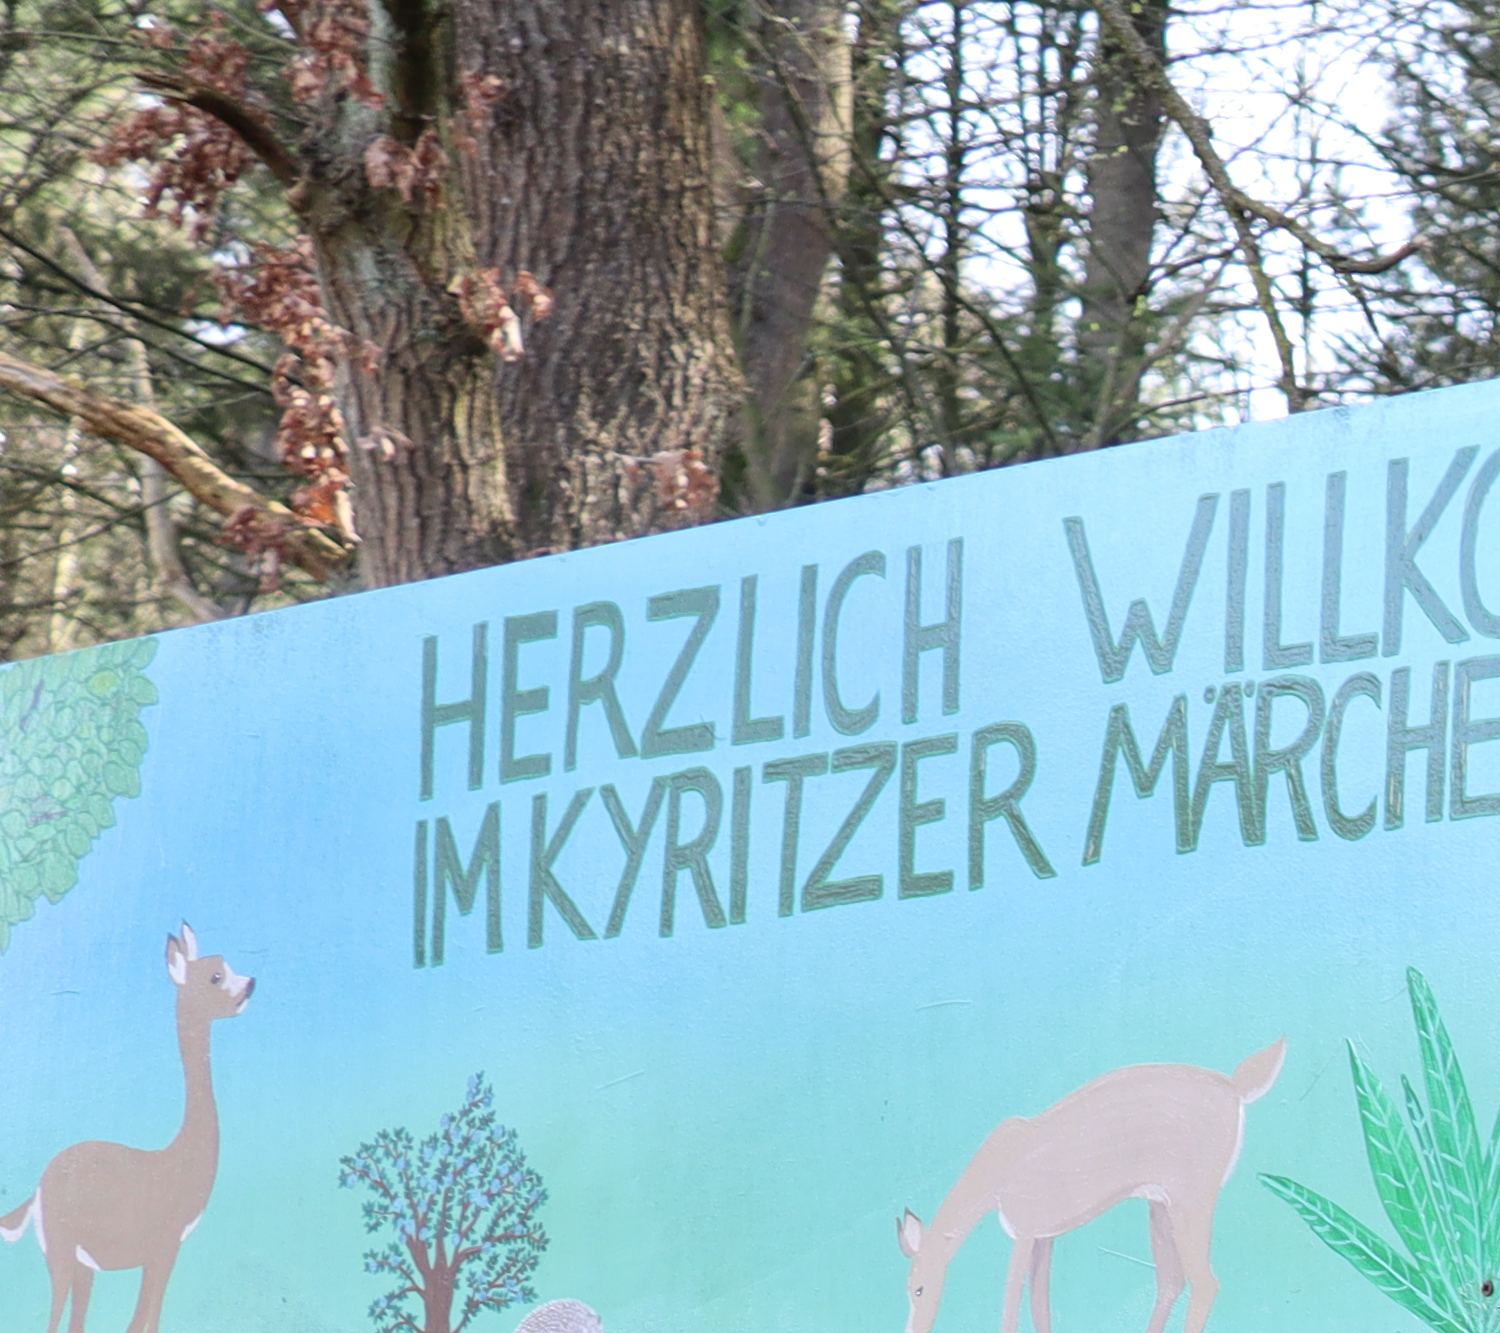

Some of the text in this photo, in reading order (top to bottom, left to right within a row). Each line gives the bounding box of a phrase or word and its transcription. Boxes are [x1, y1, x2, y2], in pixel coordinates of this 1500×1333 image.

[418, 536, 965, 799] HERZLICH
[412, 803, 503, 968] IM
[527, 720, 1055, 950] KYRITZER
